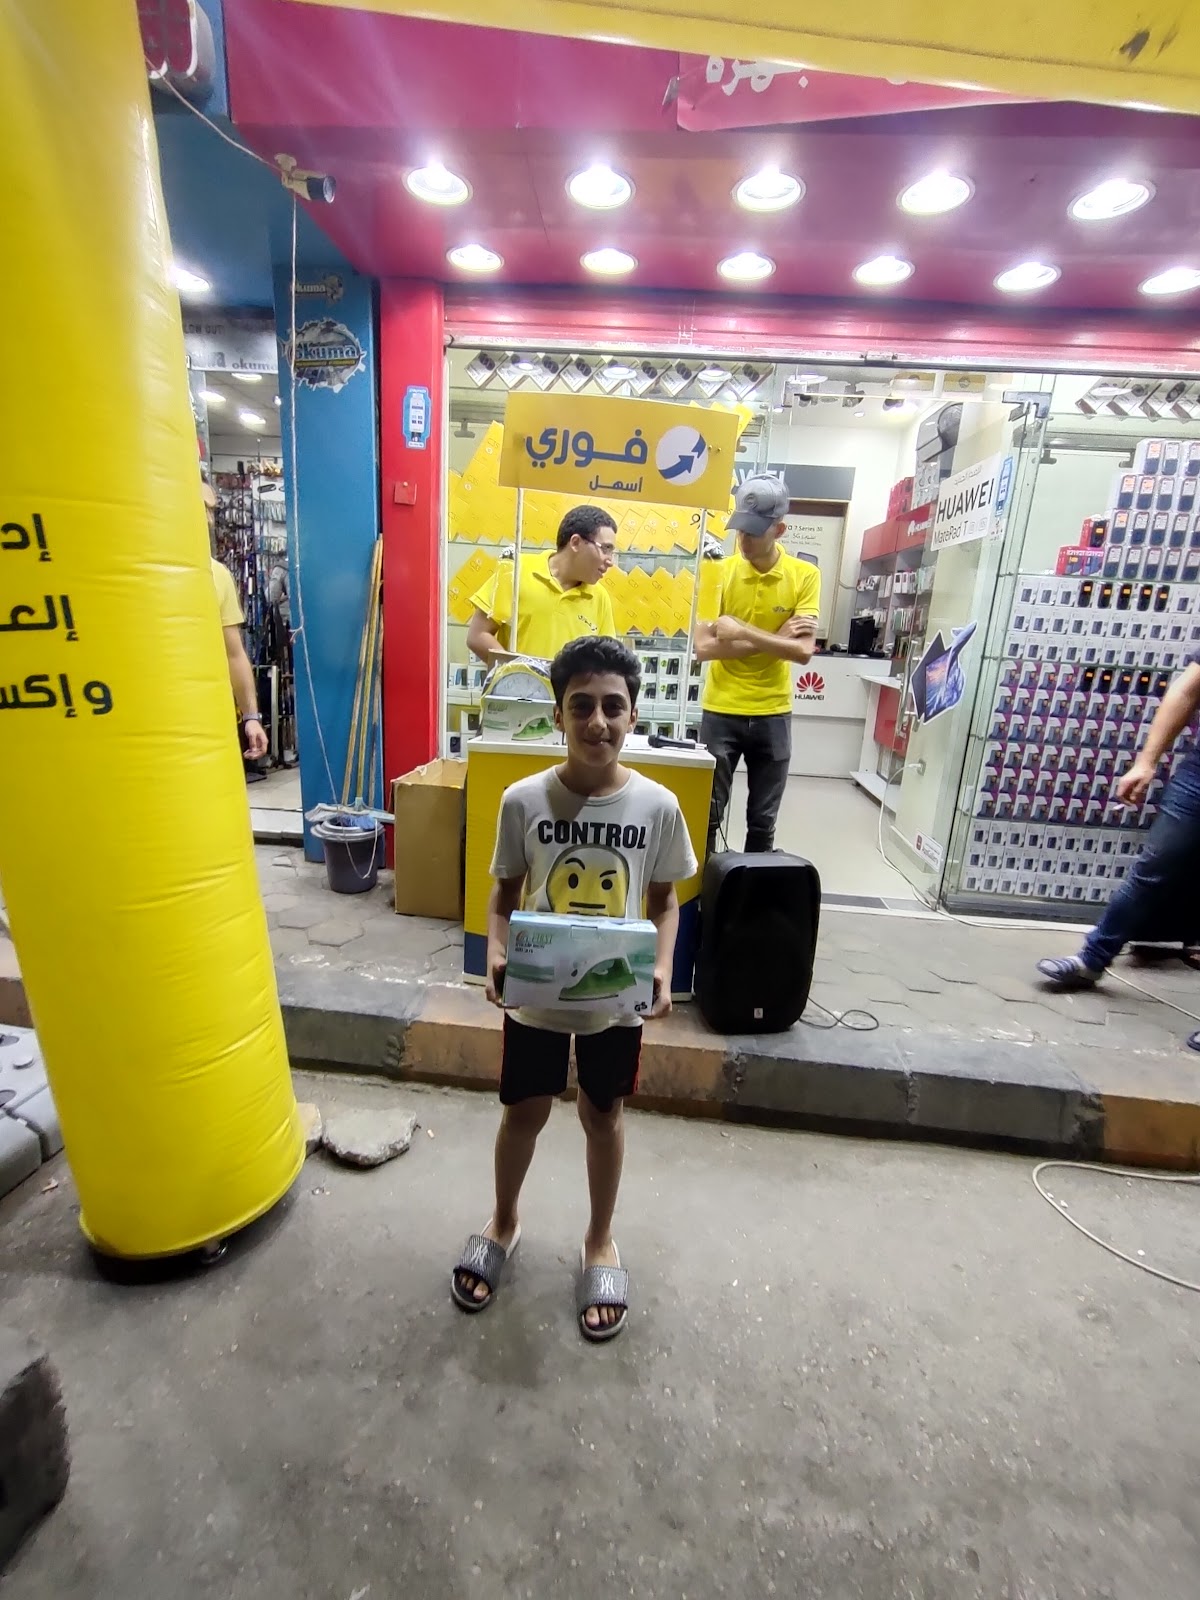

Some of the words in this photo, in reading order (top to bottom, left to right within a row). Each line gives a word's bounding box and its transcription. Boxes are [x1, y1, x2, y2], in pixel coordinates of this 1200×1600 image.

[525, 428, 649, 469] فوري
[936, 478, 995, 523] HUAWEI
[0, 595, 79, 641] إلع
[538, 819, 646, 849] CONTROL
